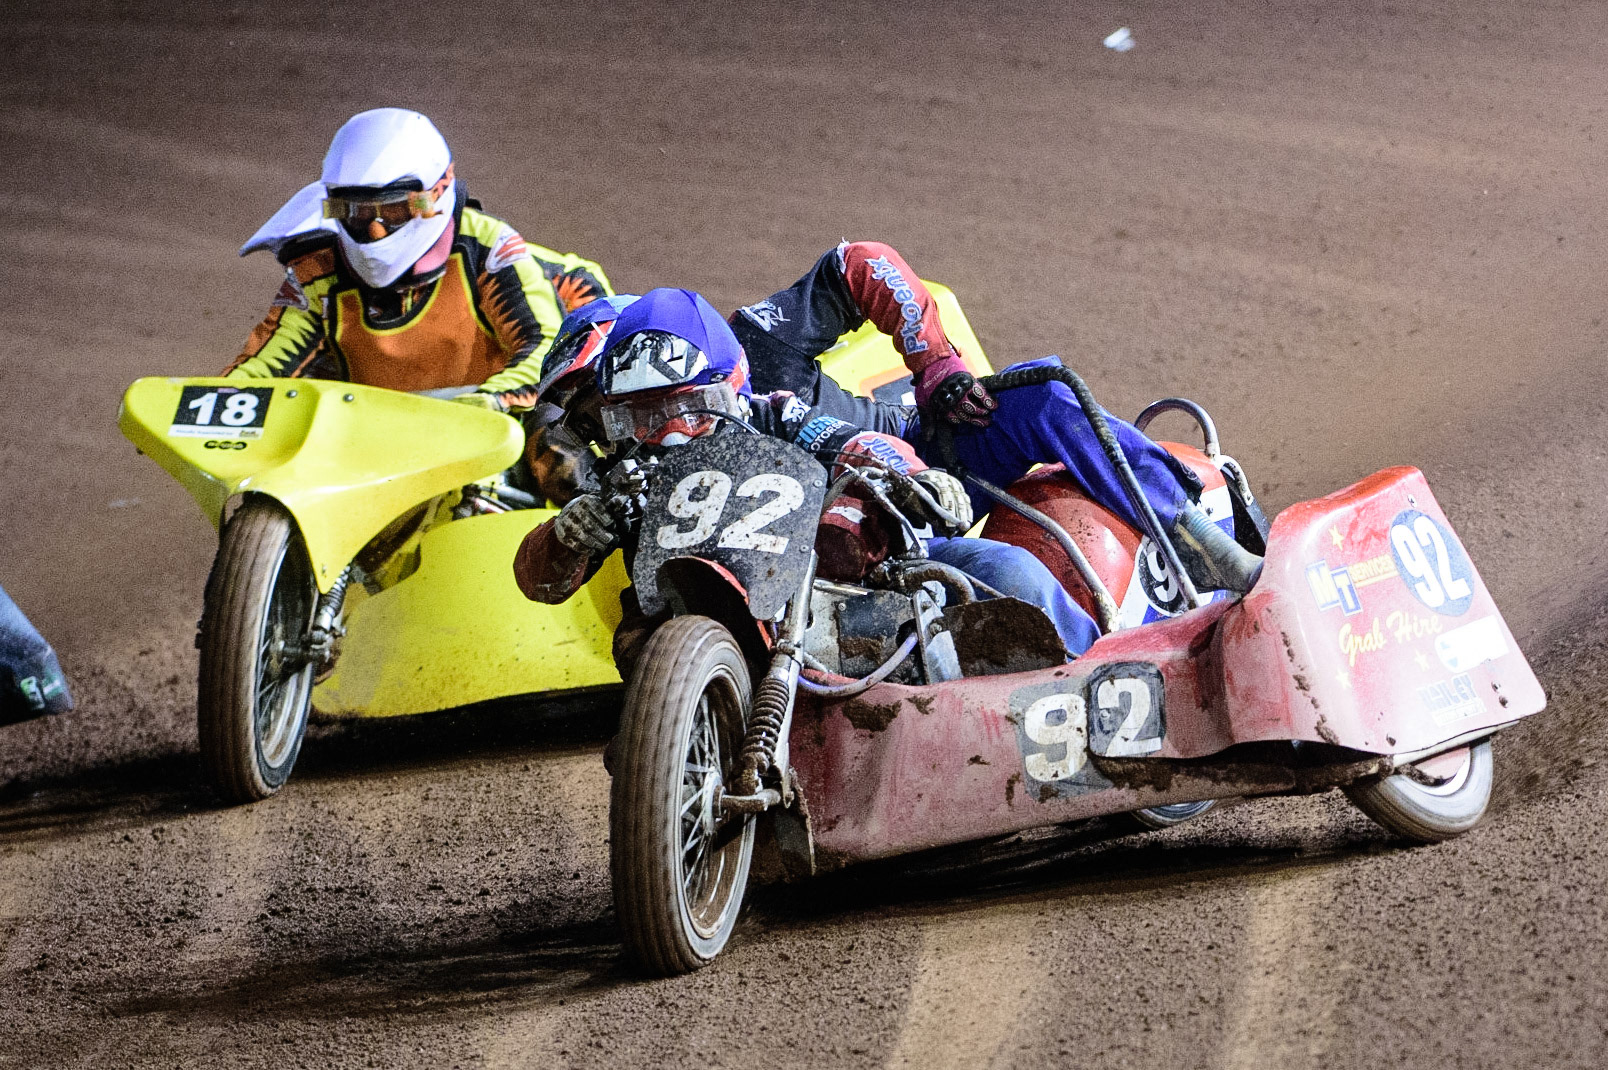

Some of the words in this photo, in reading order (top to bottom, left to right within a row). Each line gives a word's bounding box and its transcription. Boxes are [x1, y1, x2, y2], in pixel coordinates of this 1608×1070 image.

[865, 255, 928, 356] Phoenix
[188, 391, 260, 427] 18
[656, 470, 805, 555] 92
[1306, 561, 1360, 614] MT
[1390, 515, 1471, 609] 92
[1338, 616, 1387, 667] Grab
[1385, 610, 1443, 645] Hire
[1023, 677, 1163, 782] 92
